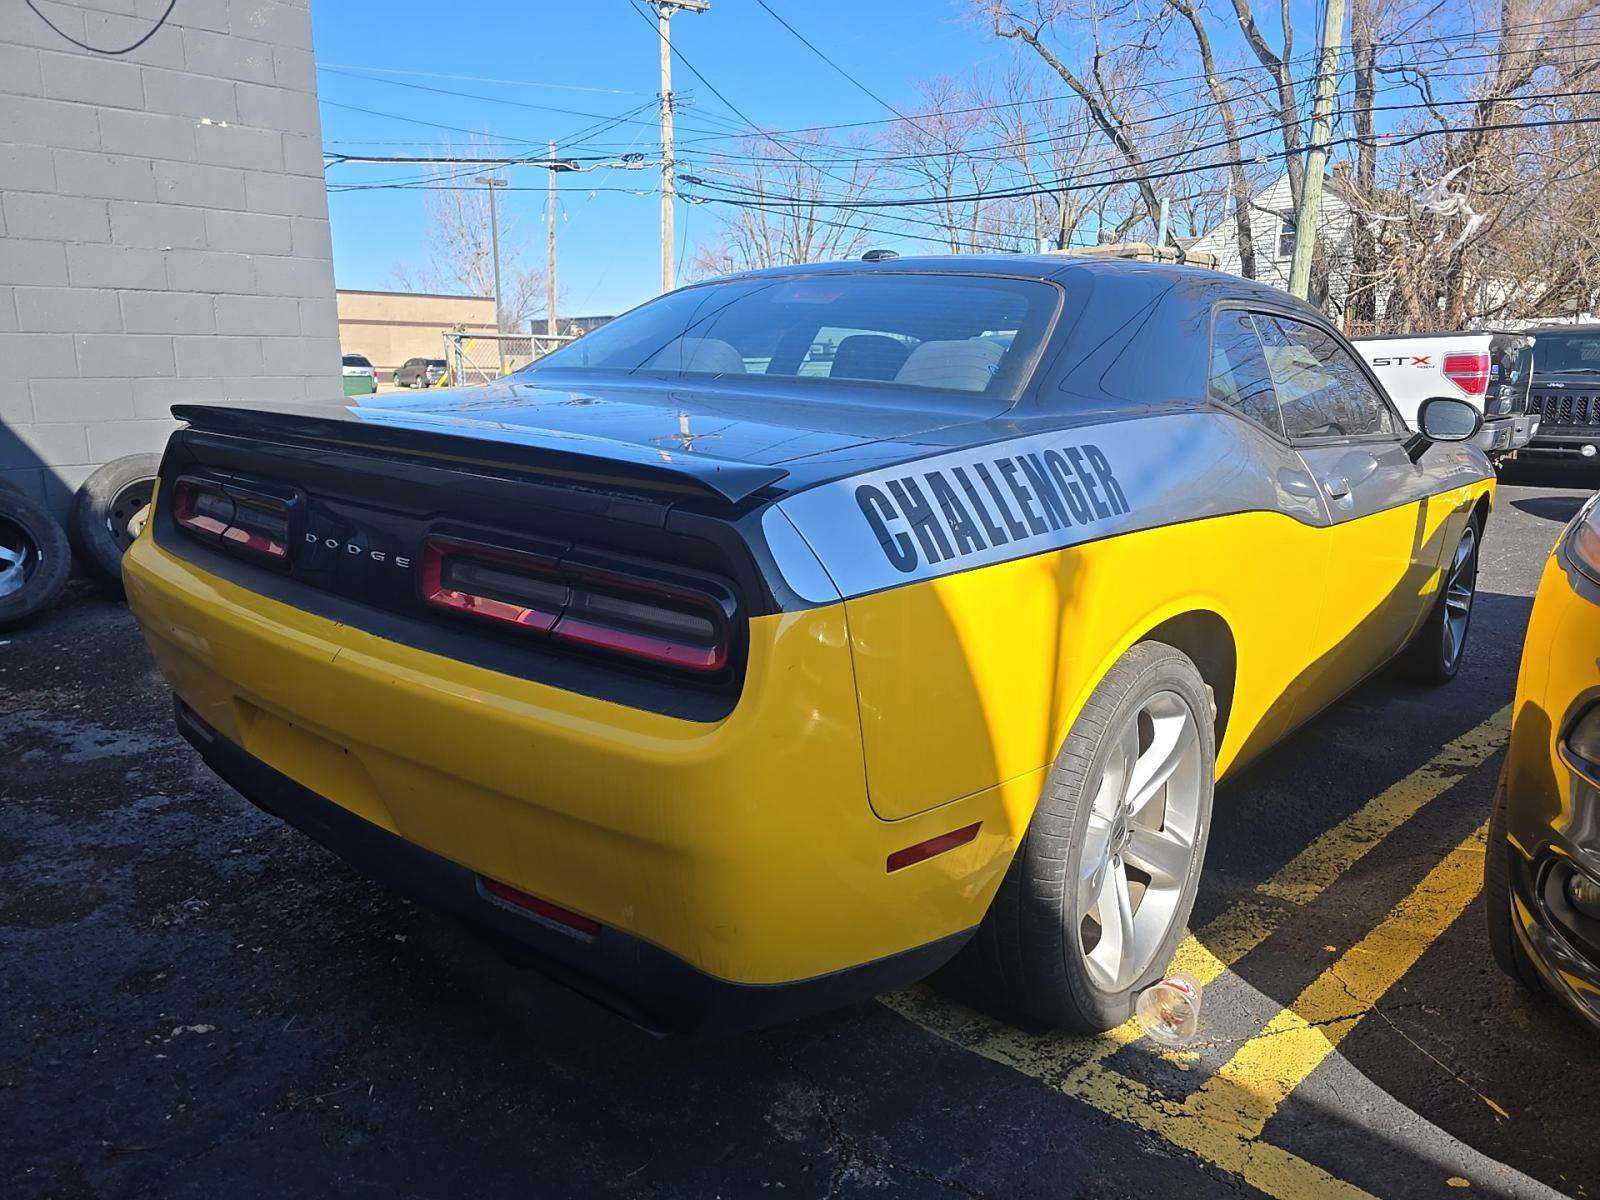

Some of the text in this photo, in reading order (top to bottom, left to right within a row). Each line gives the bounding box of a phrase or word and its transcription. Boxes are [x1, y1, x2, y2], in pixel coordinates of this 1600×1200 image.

[1373, 356, 1431, 366] STX
[855, 445, 1130, 573] CHALLENGER
[305, 533, 410, 568] DODGE
